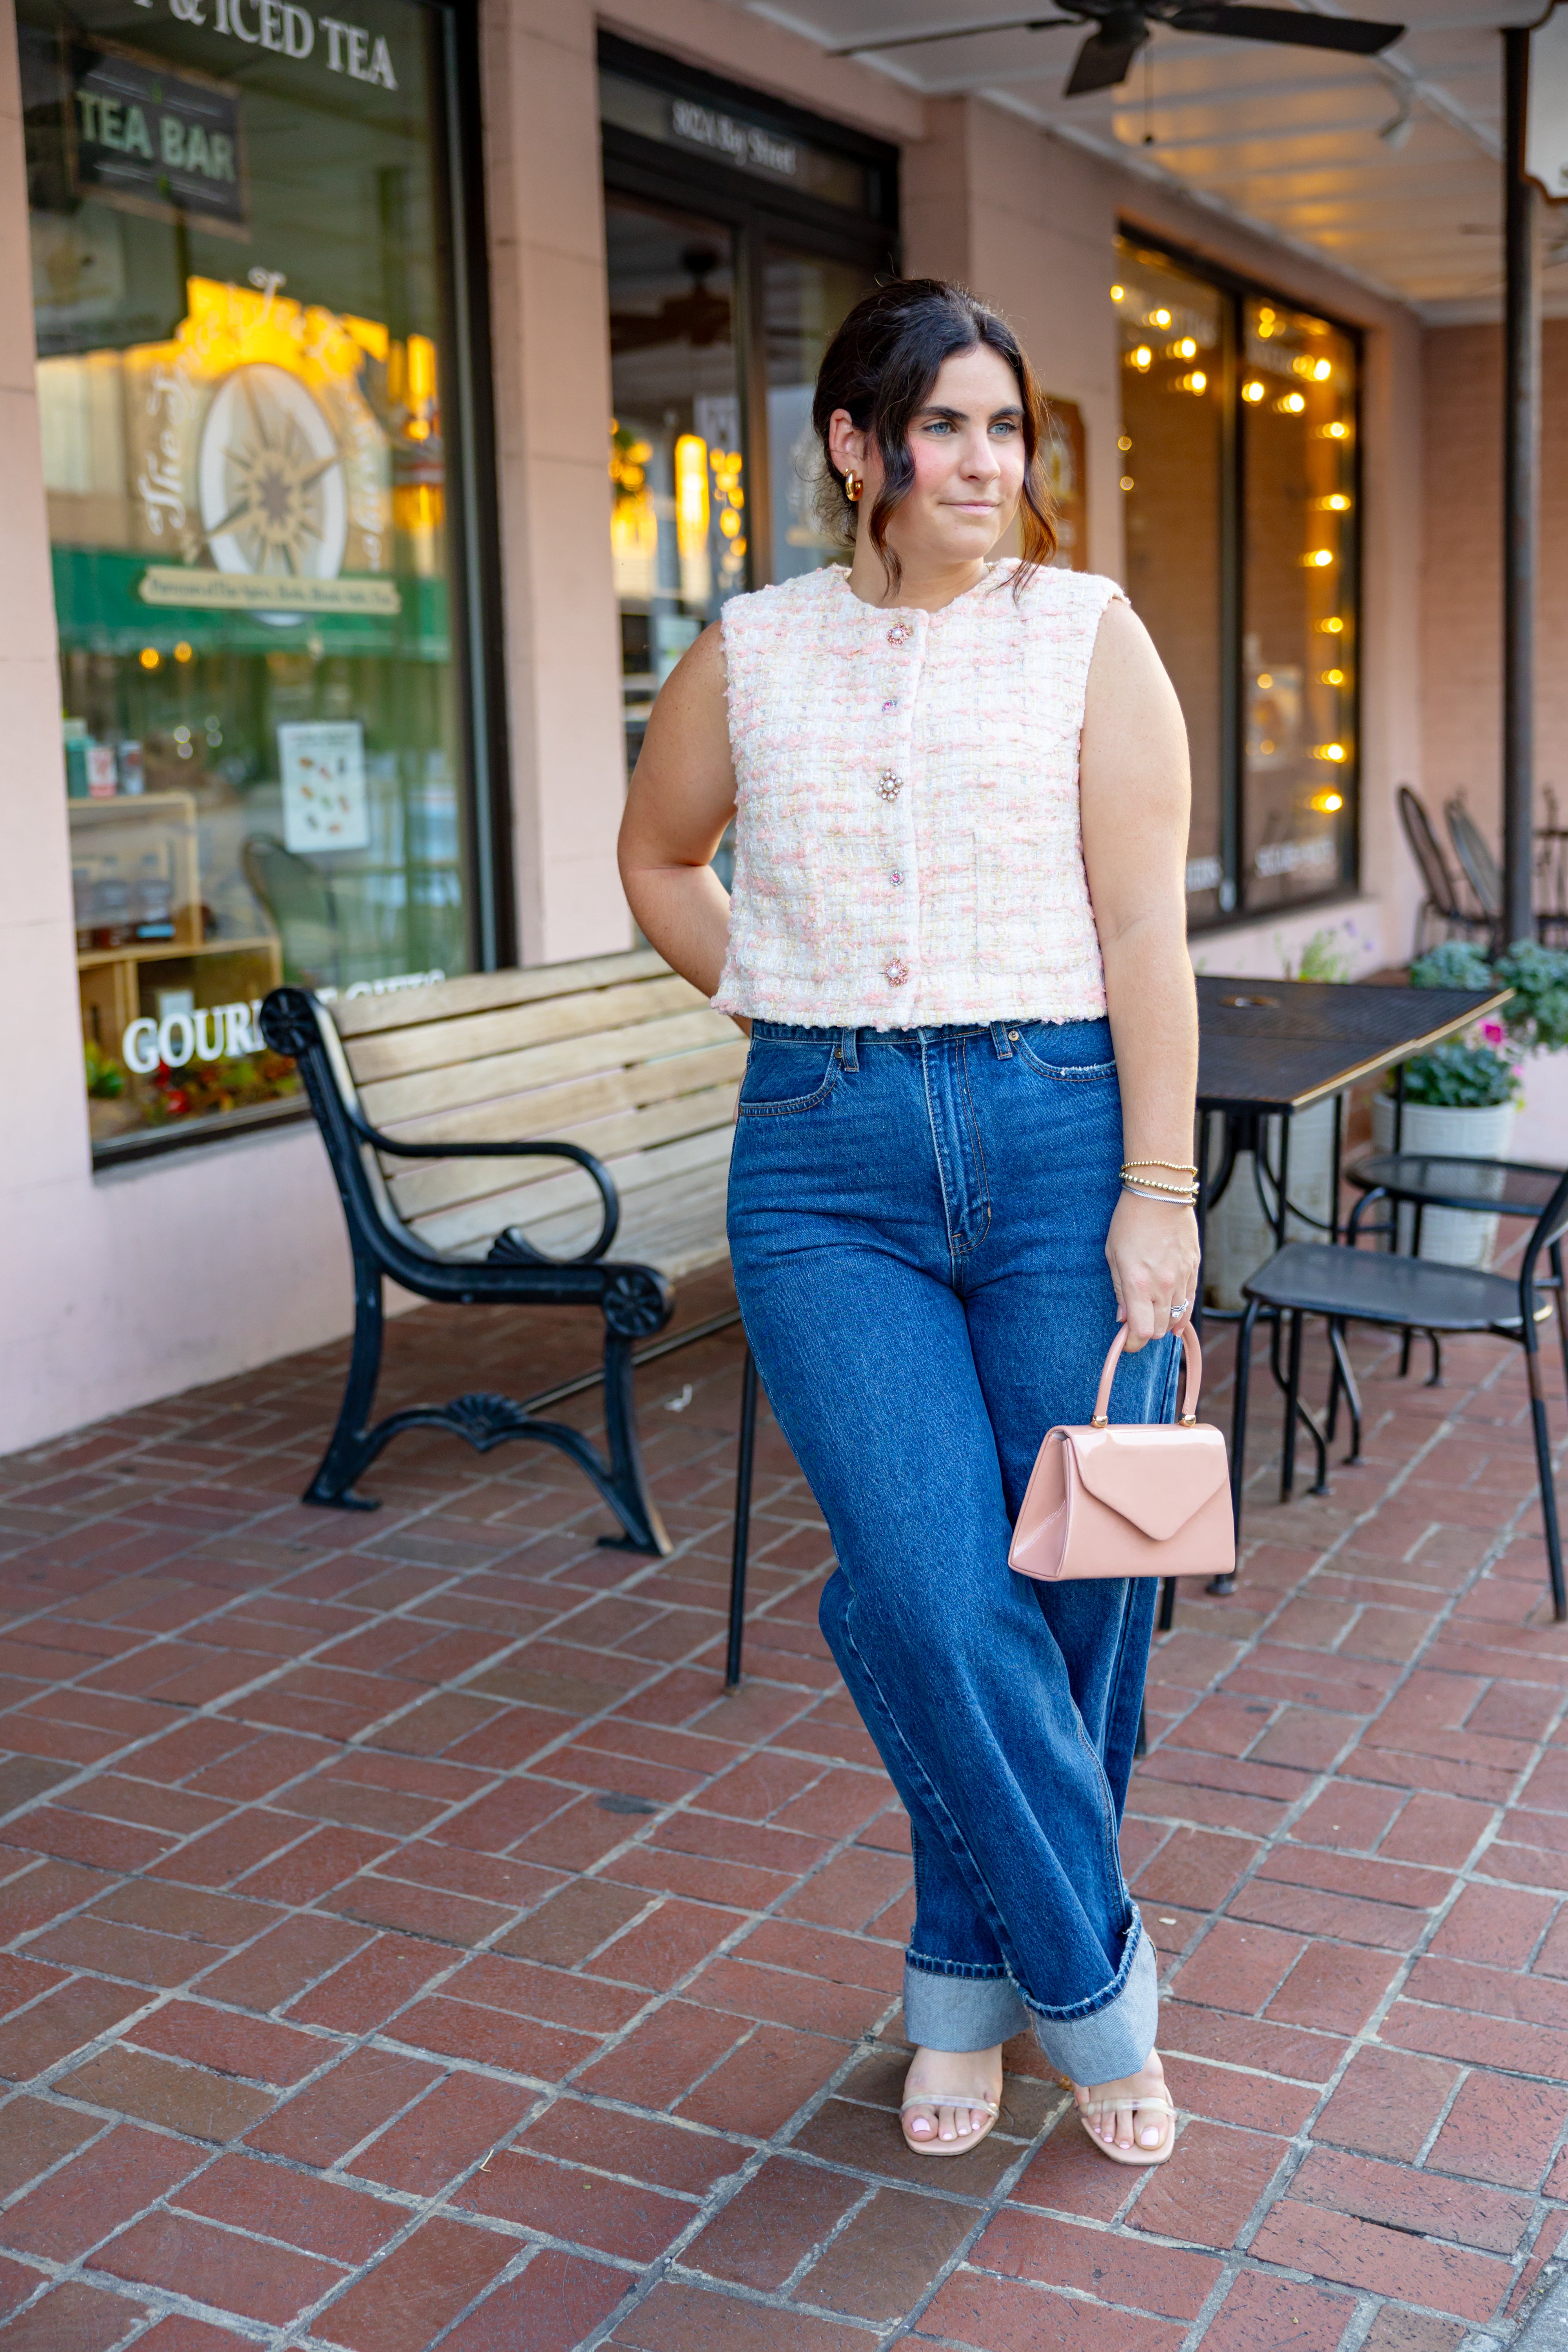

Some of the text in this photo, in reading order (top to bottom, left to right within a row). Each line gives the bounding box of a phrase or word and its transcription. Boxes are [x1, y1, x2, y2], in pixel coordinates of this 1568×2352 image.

[213, 0, 315, 59] ICED
[319, 16, 398, 91] TEA
[74, 90, 236, 183] TEA BAR
